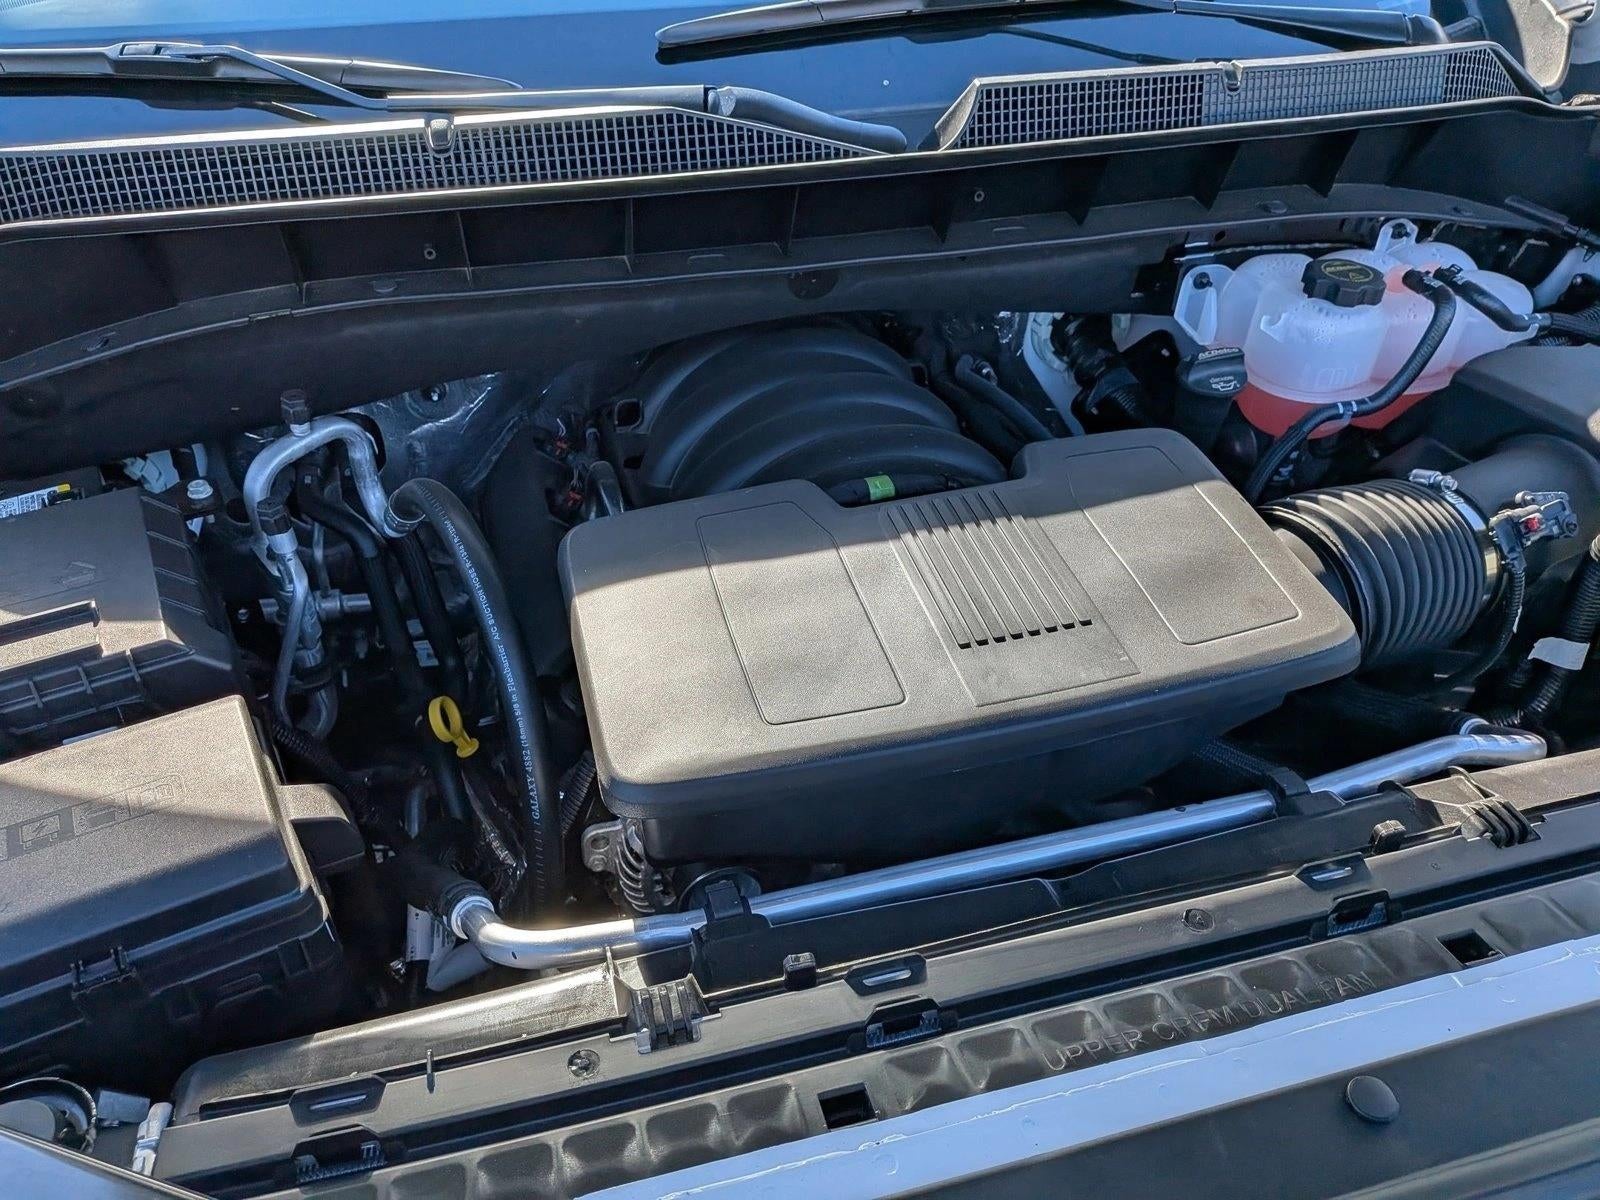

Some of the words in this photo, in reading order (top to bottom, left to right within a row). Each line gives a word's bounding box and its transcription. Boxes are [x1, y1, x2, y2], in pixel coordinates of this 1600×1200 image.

[468, 568, 482, 591] HOSE
[476, 590, 495, 625] SUCTION
[490, 625, 501, 640] A/C
[522, 749, 533, 773] 4882
[526, 774, 541, 819] GALAXY
[1041, 1029, 1149, 1071] UPPER
[1238, 987, 1321, 1019] DUAL
[1316, 970, 1378, 1001] FAN
